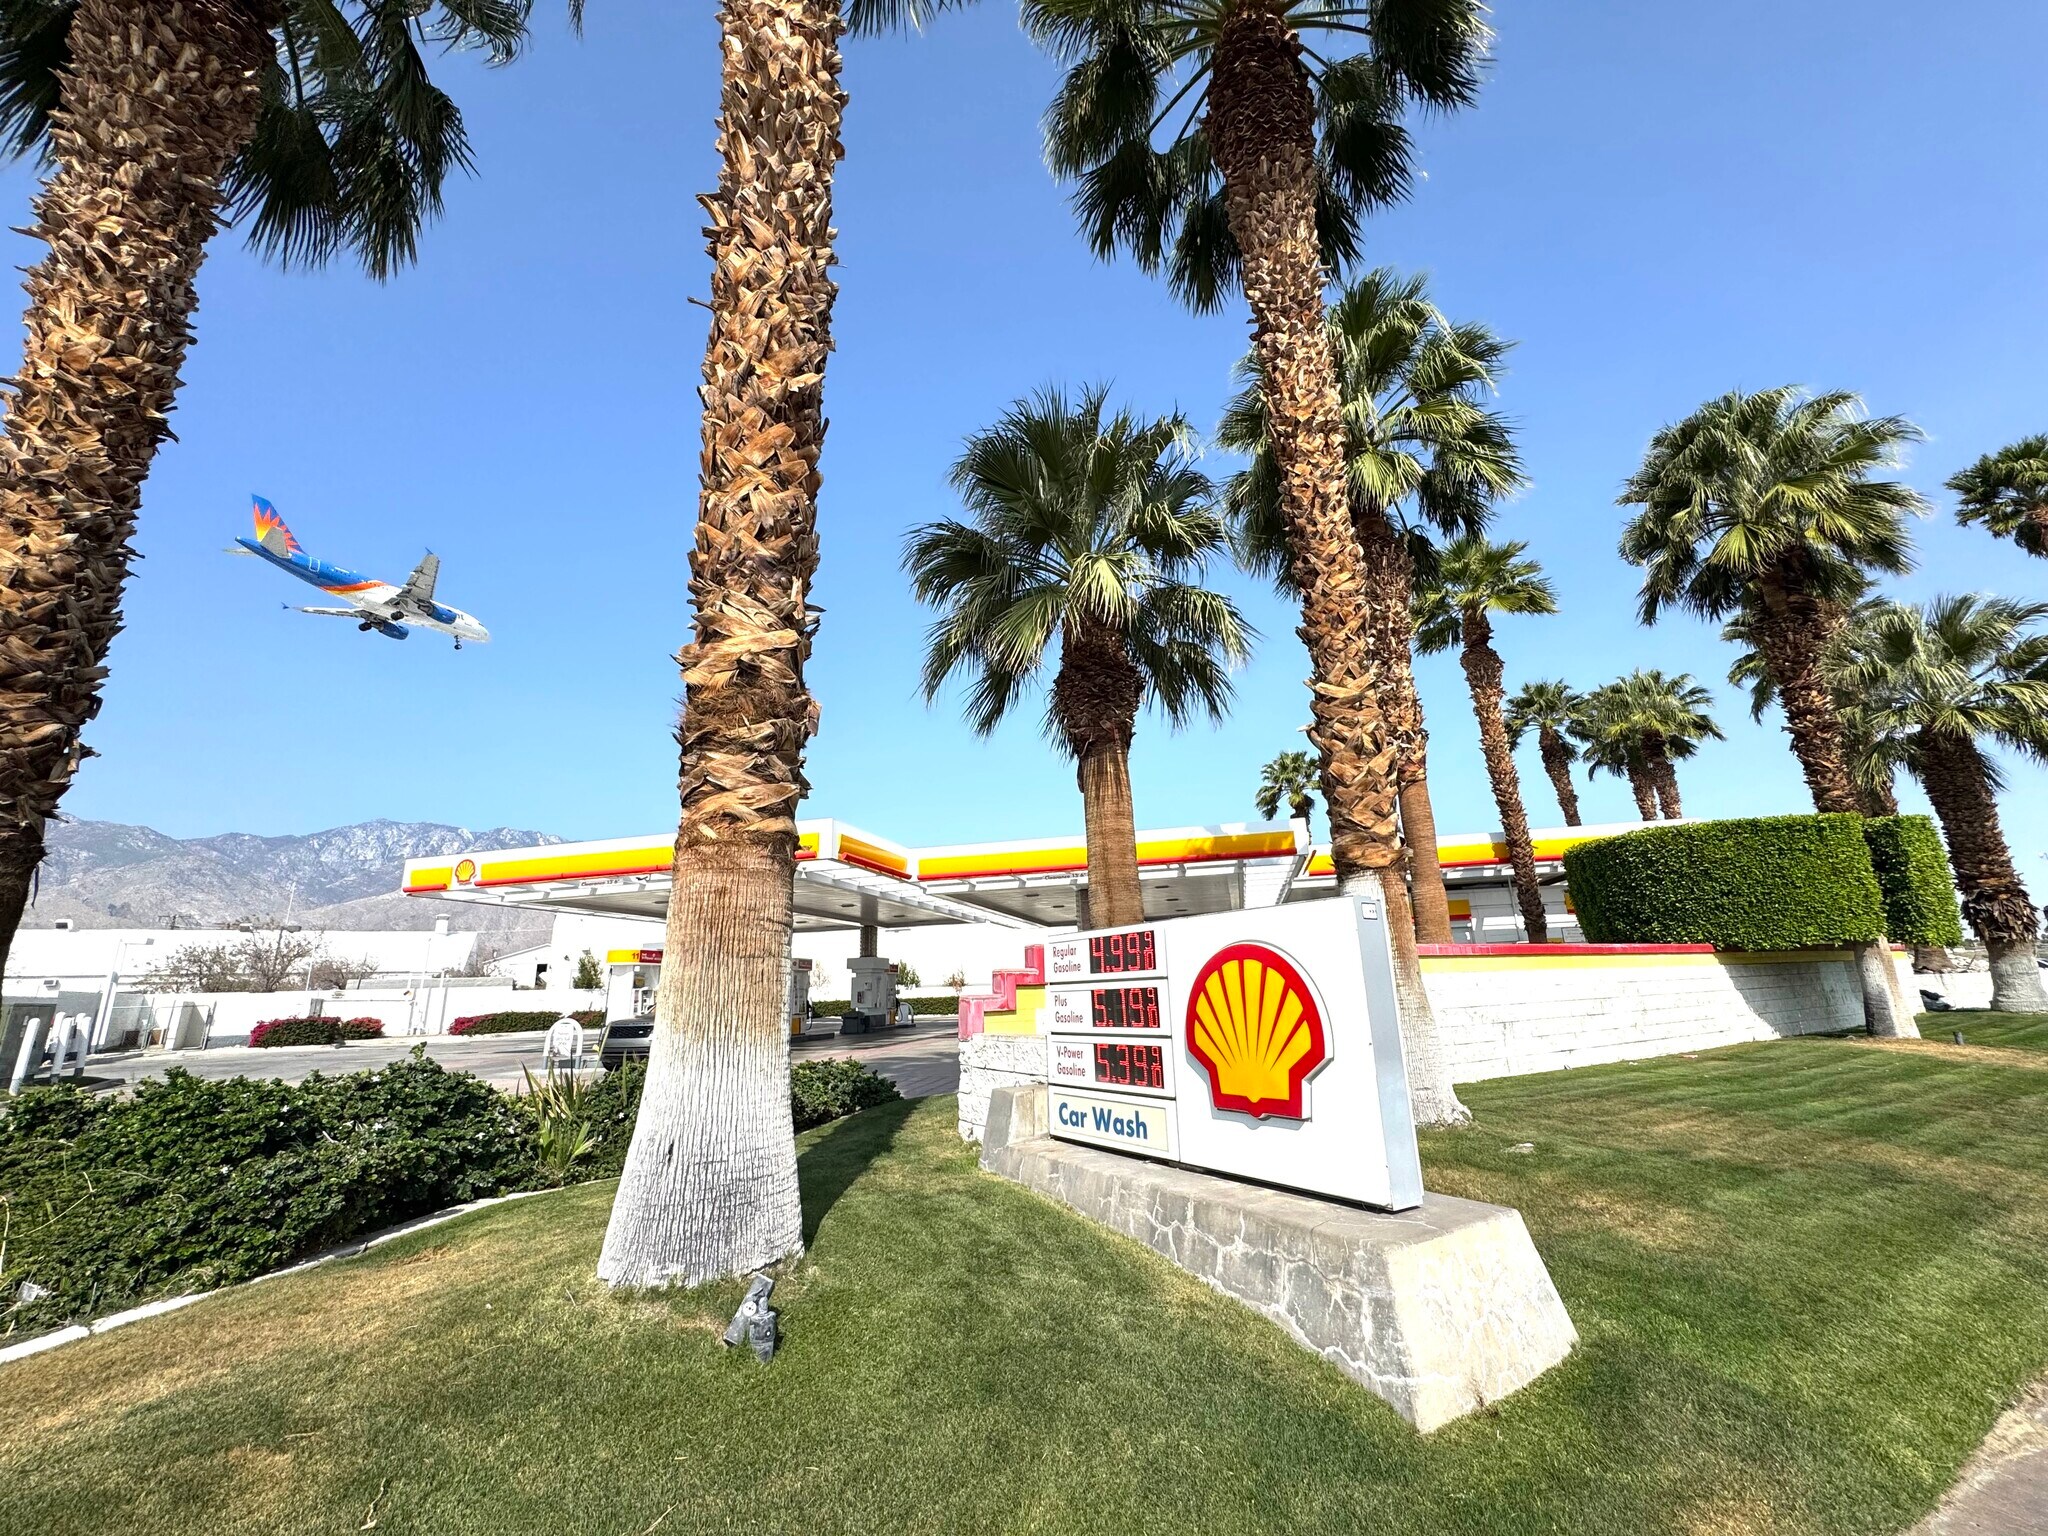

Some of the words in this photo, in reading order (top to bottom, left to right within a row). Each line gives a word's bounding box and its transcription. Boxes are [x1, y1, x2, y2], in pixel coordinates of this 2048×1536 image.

[1053, 944, 1077, 959] Regular
[1092, 932, 1140, 972] 4.99
[1053, 960, 1081, 973] Gasoline
[1054, 994, 1068, 1007] Plus
[1094, 988, 1145, 1027] 5.19
[1055, 1010, 1083, 1023] Gasoline
[1056, 1045, 1083, 1059] V-Power
[1057, 1062, 1086, 1077] Gasoline
[1096, 1043, 1148, 1086] 5.39
[1058, 1102, 1087, 1127] Car
[1092, 1106, 1148, 1139] Wash
